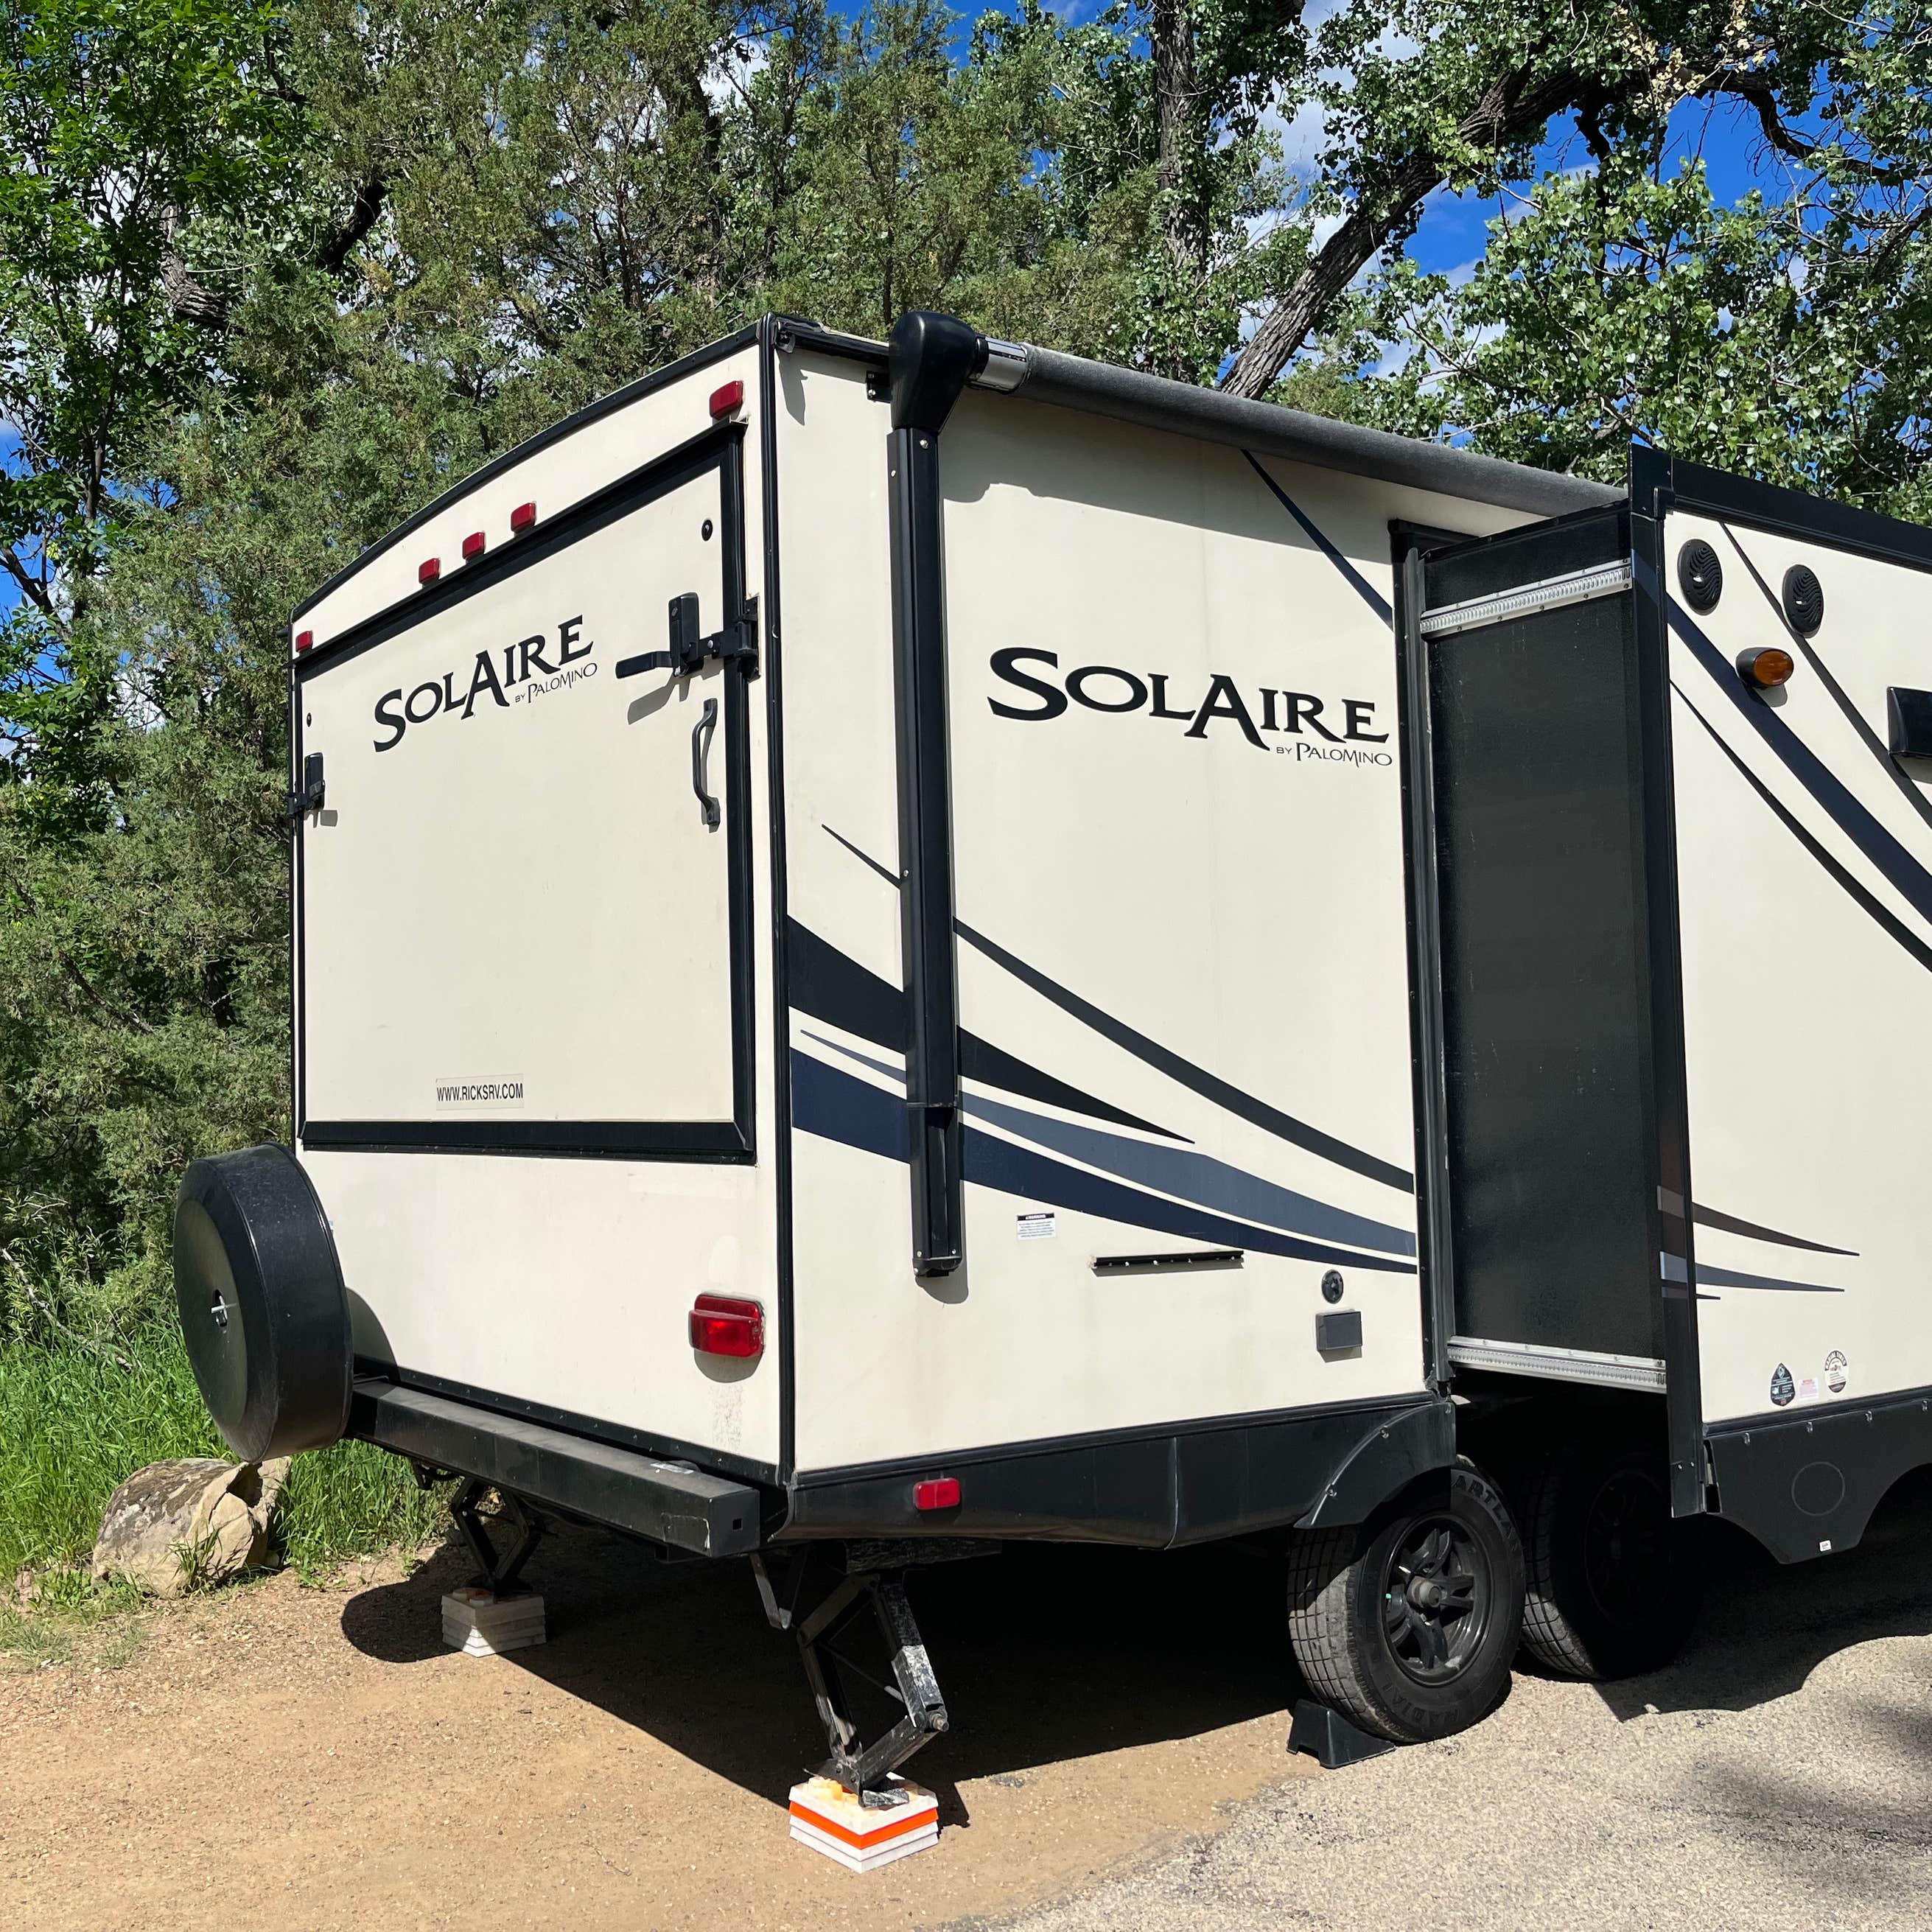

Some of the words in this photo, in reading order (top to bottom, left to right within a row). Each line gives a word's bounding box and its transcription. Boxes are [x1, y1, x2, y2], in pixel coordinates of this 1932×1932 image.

[373, 614, 594, 753] SOLAIRE
[514, 694, 525, 704] BY
[528, 662, 598, 704] PALOMINO
[987, 647, 1390, 752] SOLAIRE
[1276, 746, 1292, 755] BY
[1295, 742, 1393, 768] PALOMINO
[436, 1082, 523, 1102] WWW.RICKSRV.COM
